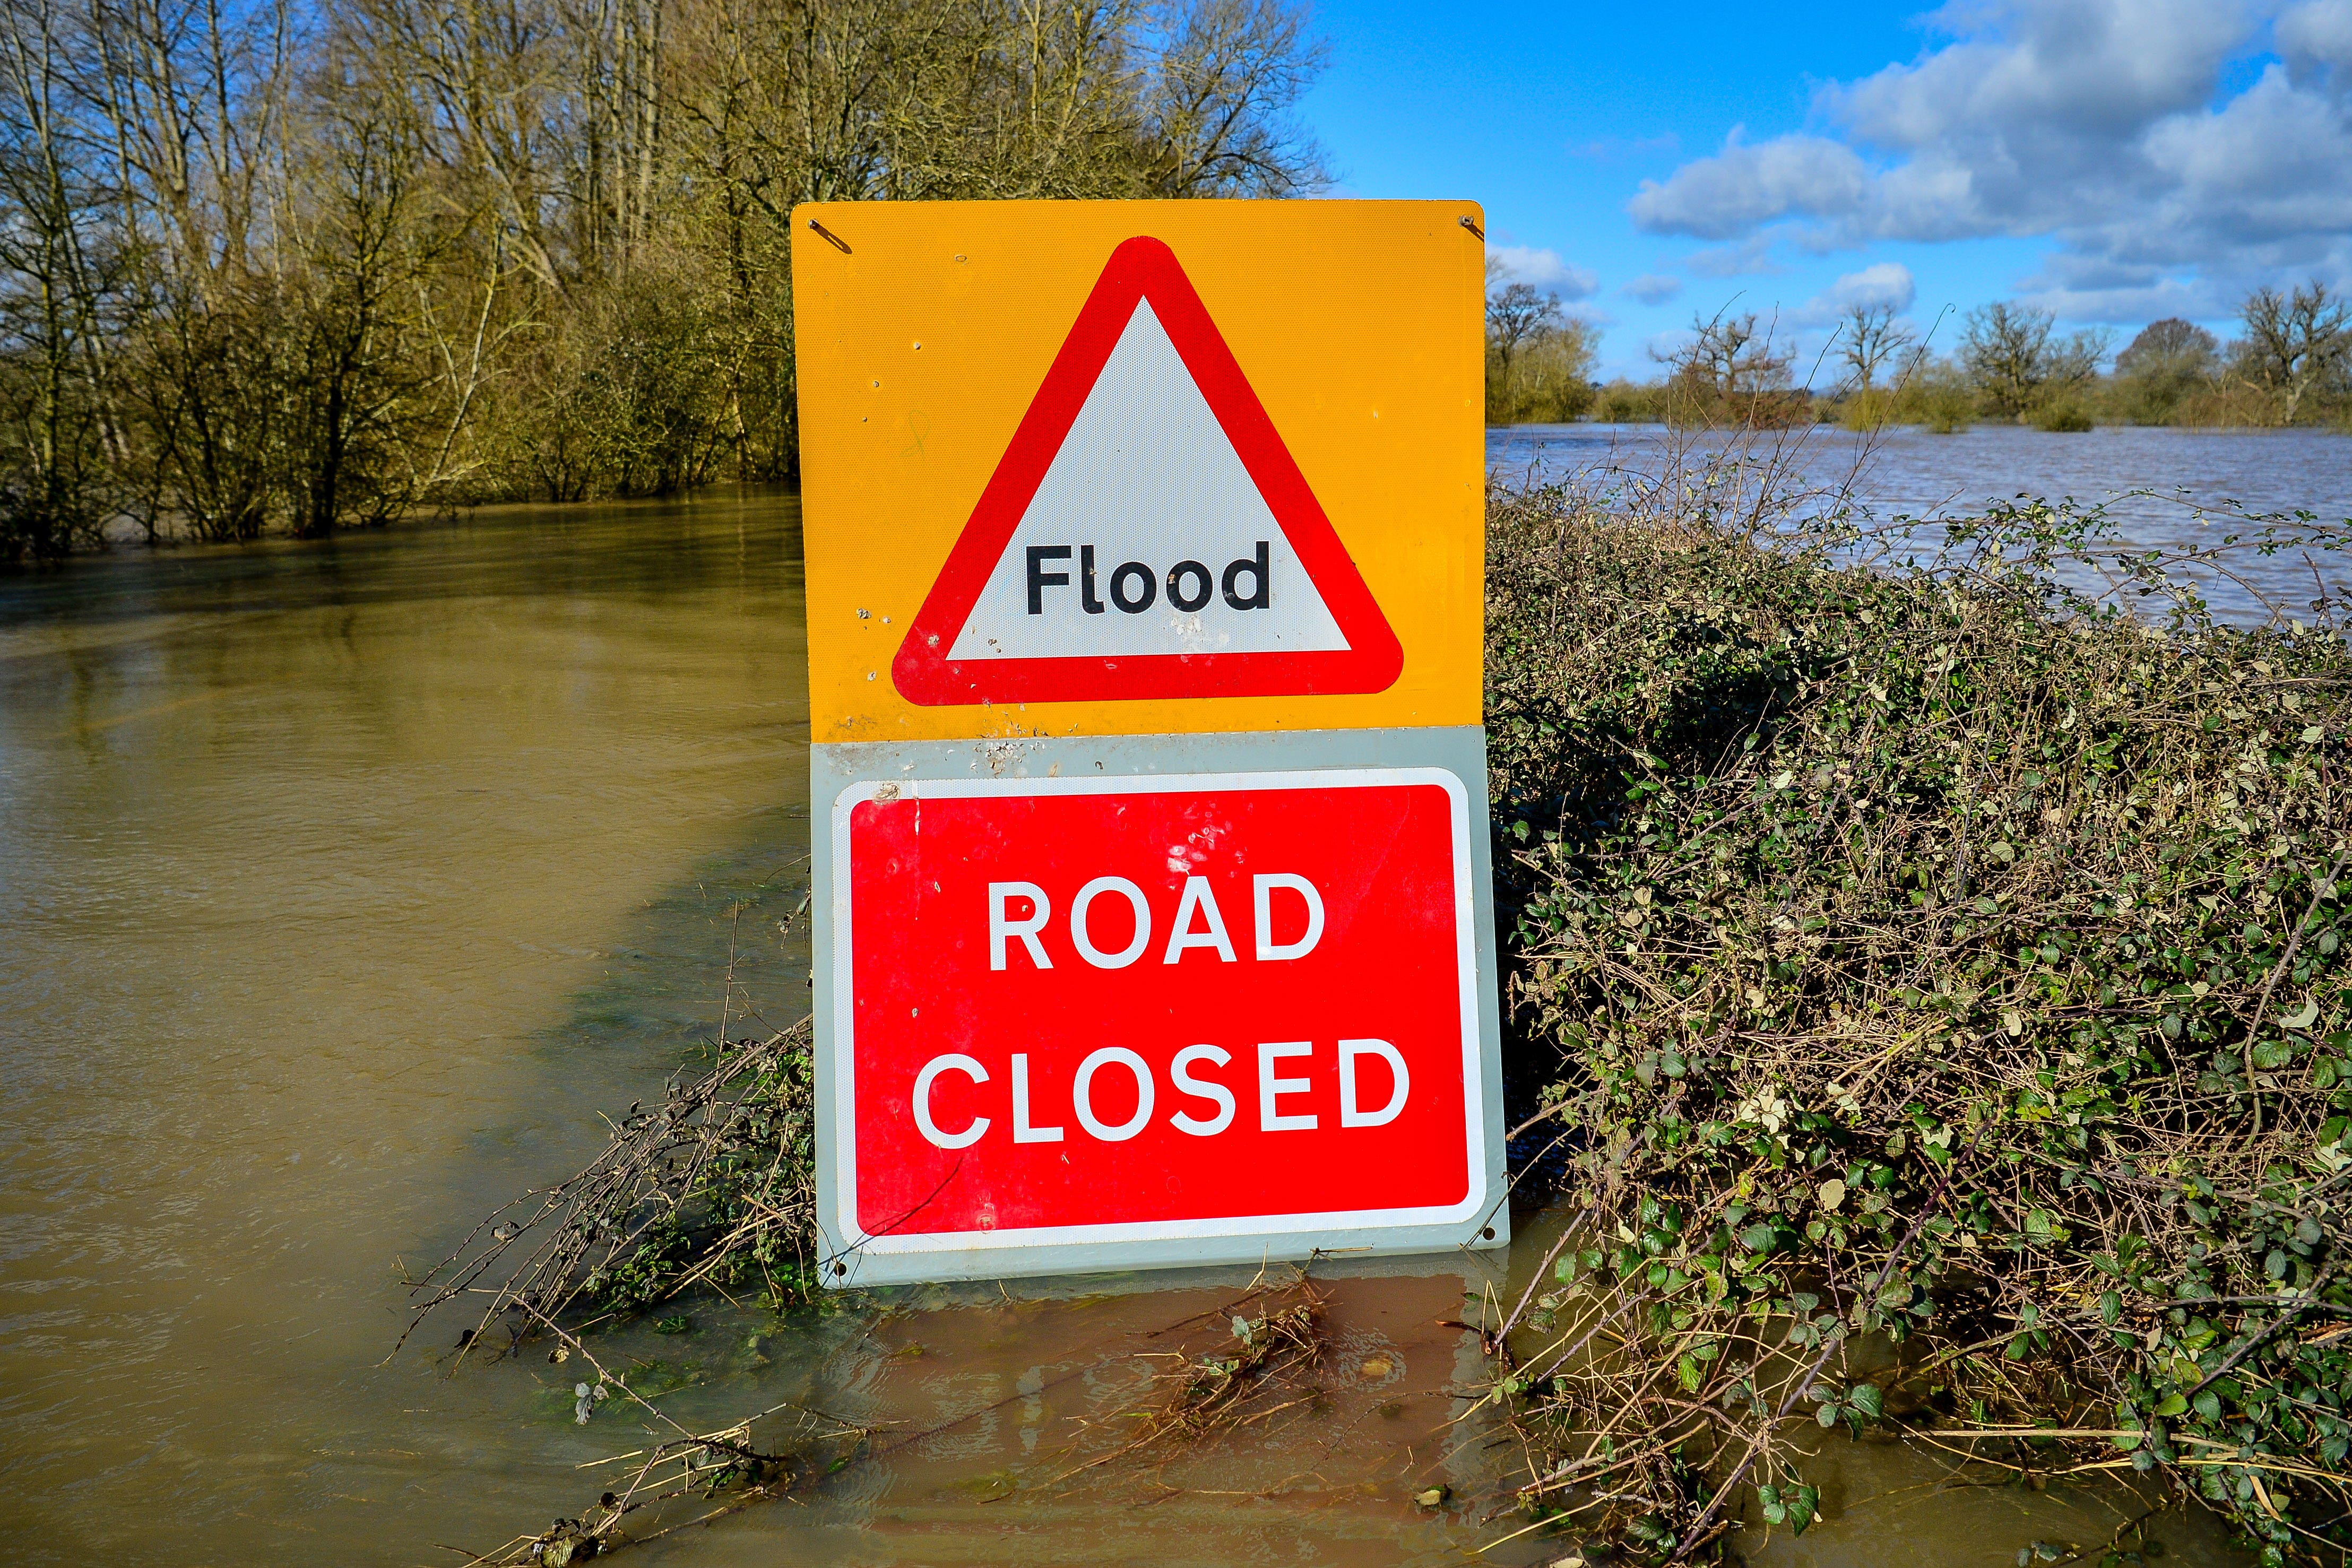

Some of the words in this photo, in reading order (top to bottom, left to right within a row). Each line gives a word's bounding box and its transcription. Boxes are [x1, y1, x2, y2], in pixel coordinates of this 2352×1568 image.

[1025, 541, 1270, 615] Flood
[988, 873, 1325, 971] ROAD
[912, 1038, 1410, 1150] CLOSED
